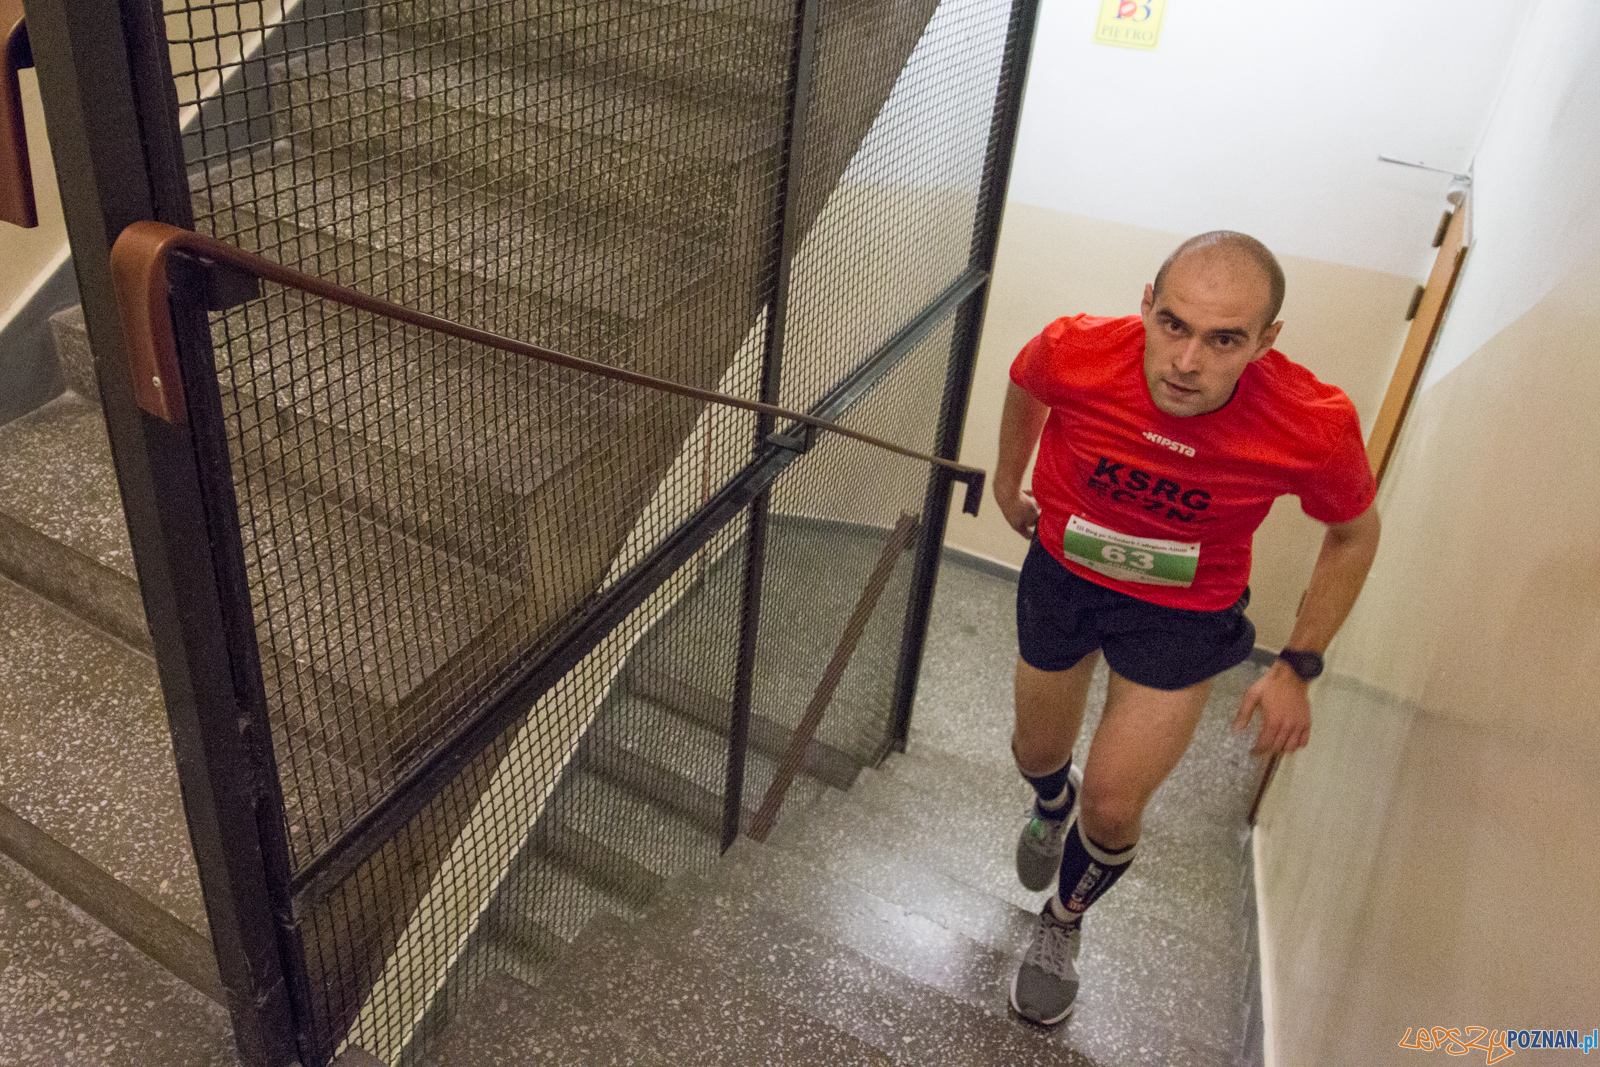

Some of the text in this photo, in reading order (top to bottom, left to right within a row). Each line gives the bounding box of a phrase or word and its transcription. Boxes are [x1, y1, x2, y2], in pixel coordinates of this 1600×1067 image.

[1146, 431, 1196, 458] KIPSTA
[1094, 456, 1212, 511] KSRG
[1101, 544, 1154, 570] 63
